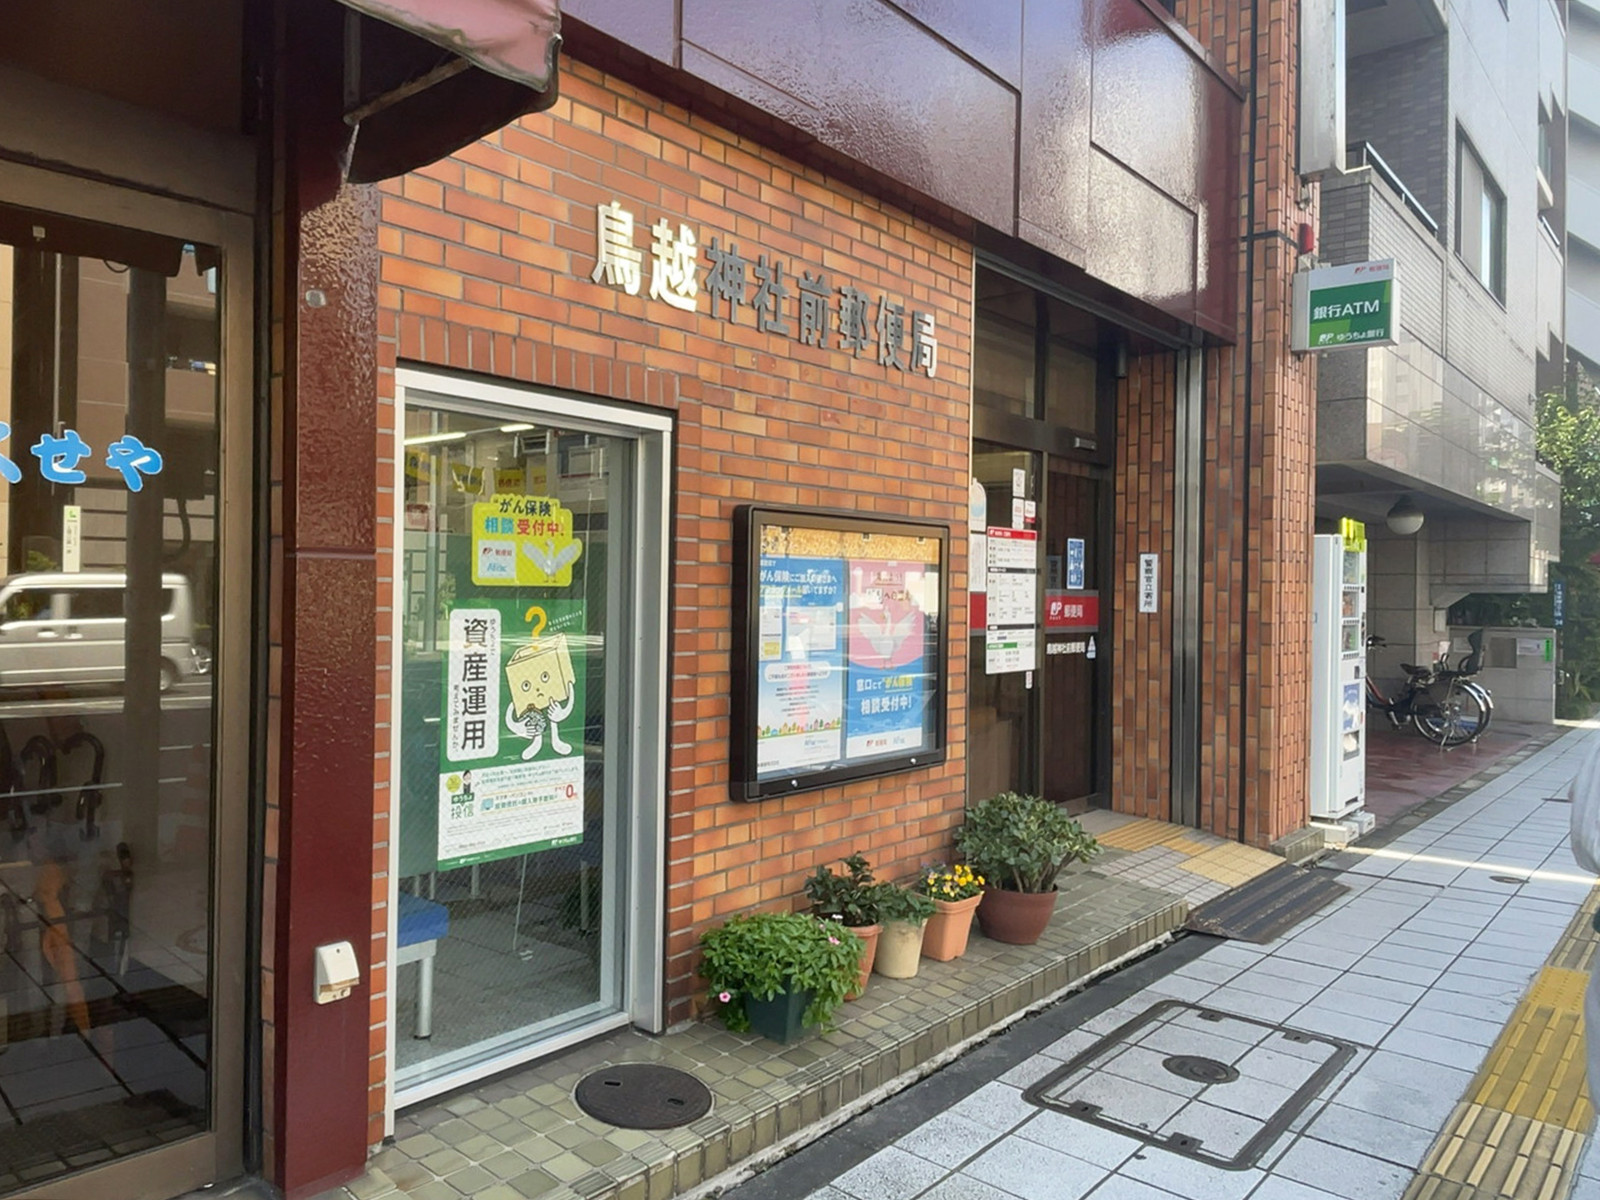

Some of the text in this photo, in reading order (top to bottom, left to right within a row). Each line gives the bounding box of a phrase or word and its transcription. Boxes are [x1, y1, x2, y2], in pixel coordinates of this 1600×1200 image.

[591, 201, 938, 379] 鳥越神社前郵便局
[1313, 299, 1379, 320] 銀行ATM
[1336, 328, 1384, 341] ゆうちょ銀行
[461, 618, 489, 750] 資産運用
